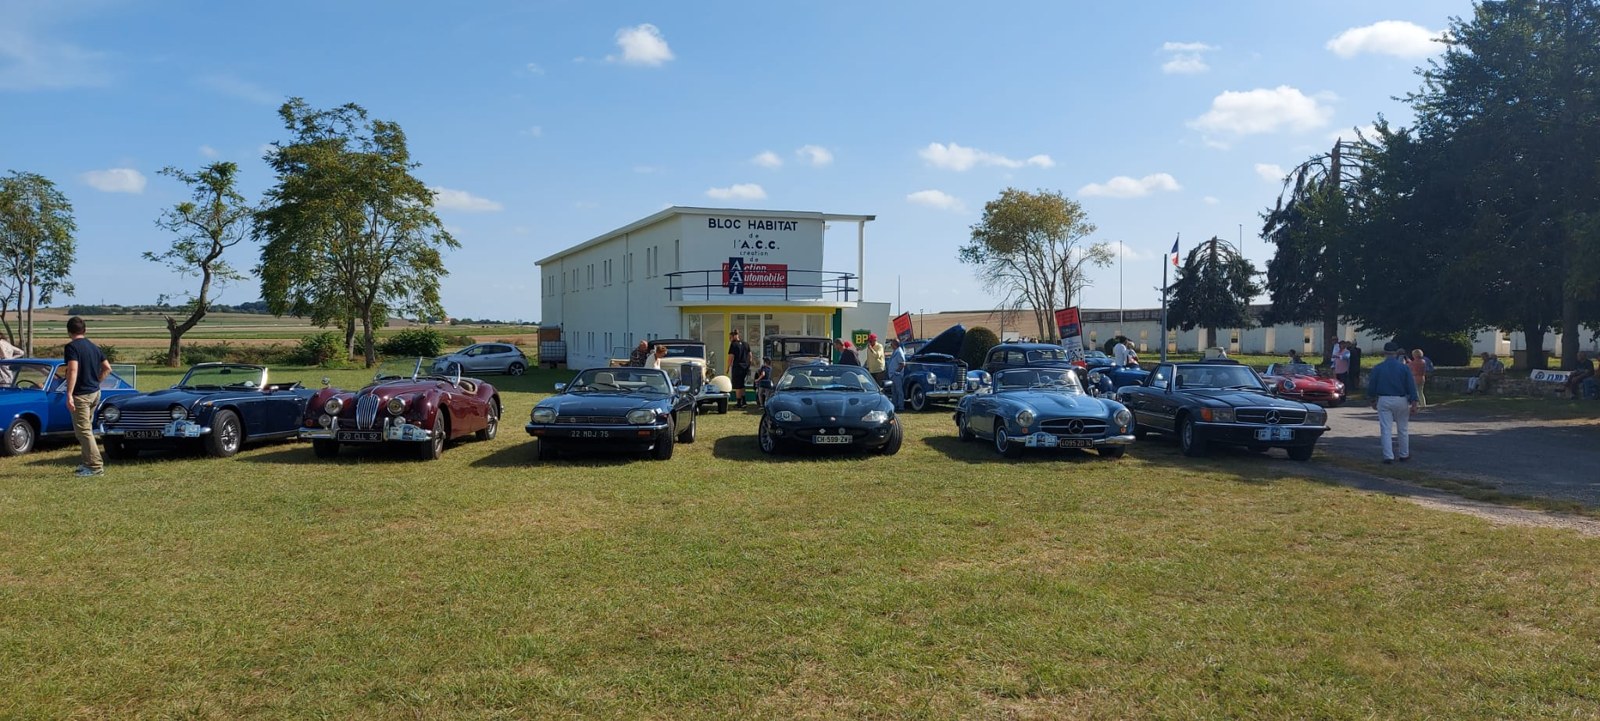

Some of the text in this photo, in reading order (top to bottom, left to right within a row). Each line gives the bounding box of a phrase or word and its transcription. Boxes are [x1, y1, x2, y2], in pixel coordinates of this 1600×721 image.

[708, 217, 798, 231] BLOC HABITAT
[855, 334, 869, 344] BP
[600, 430, 609, 438] 75
